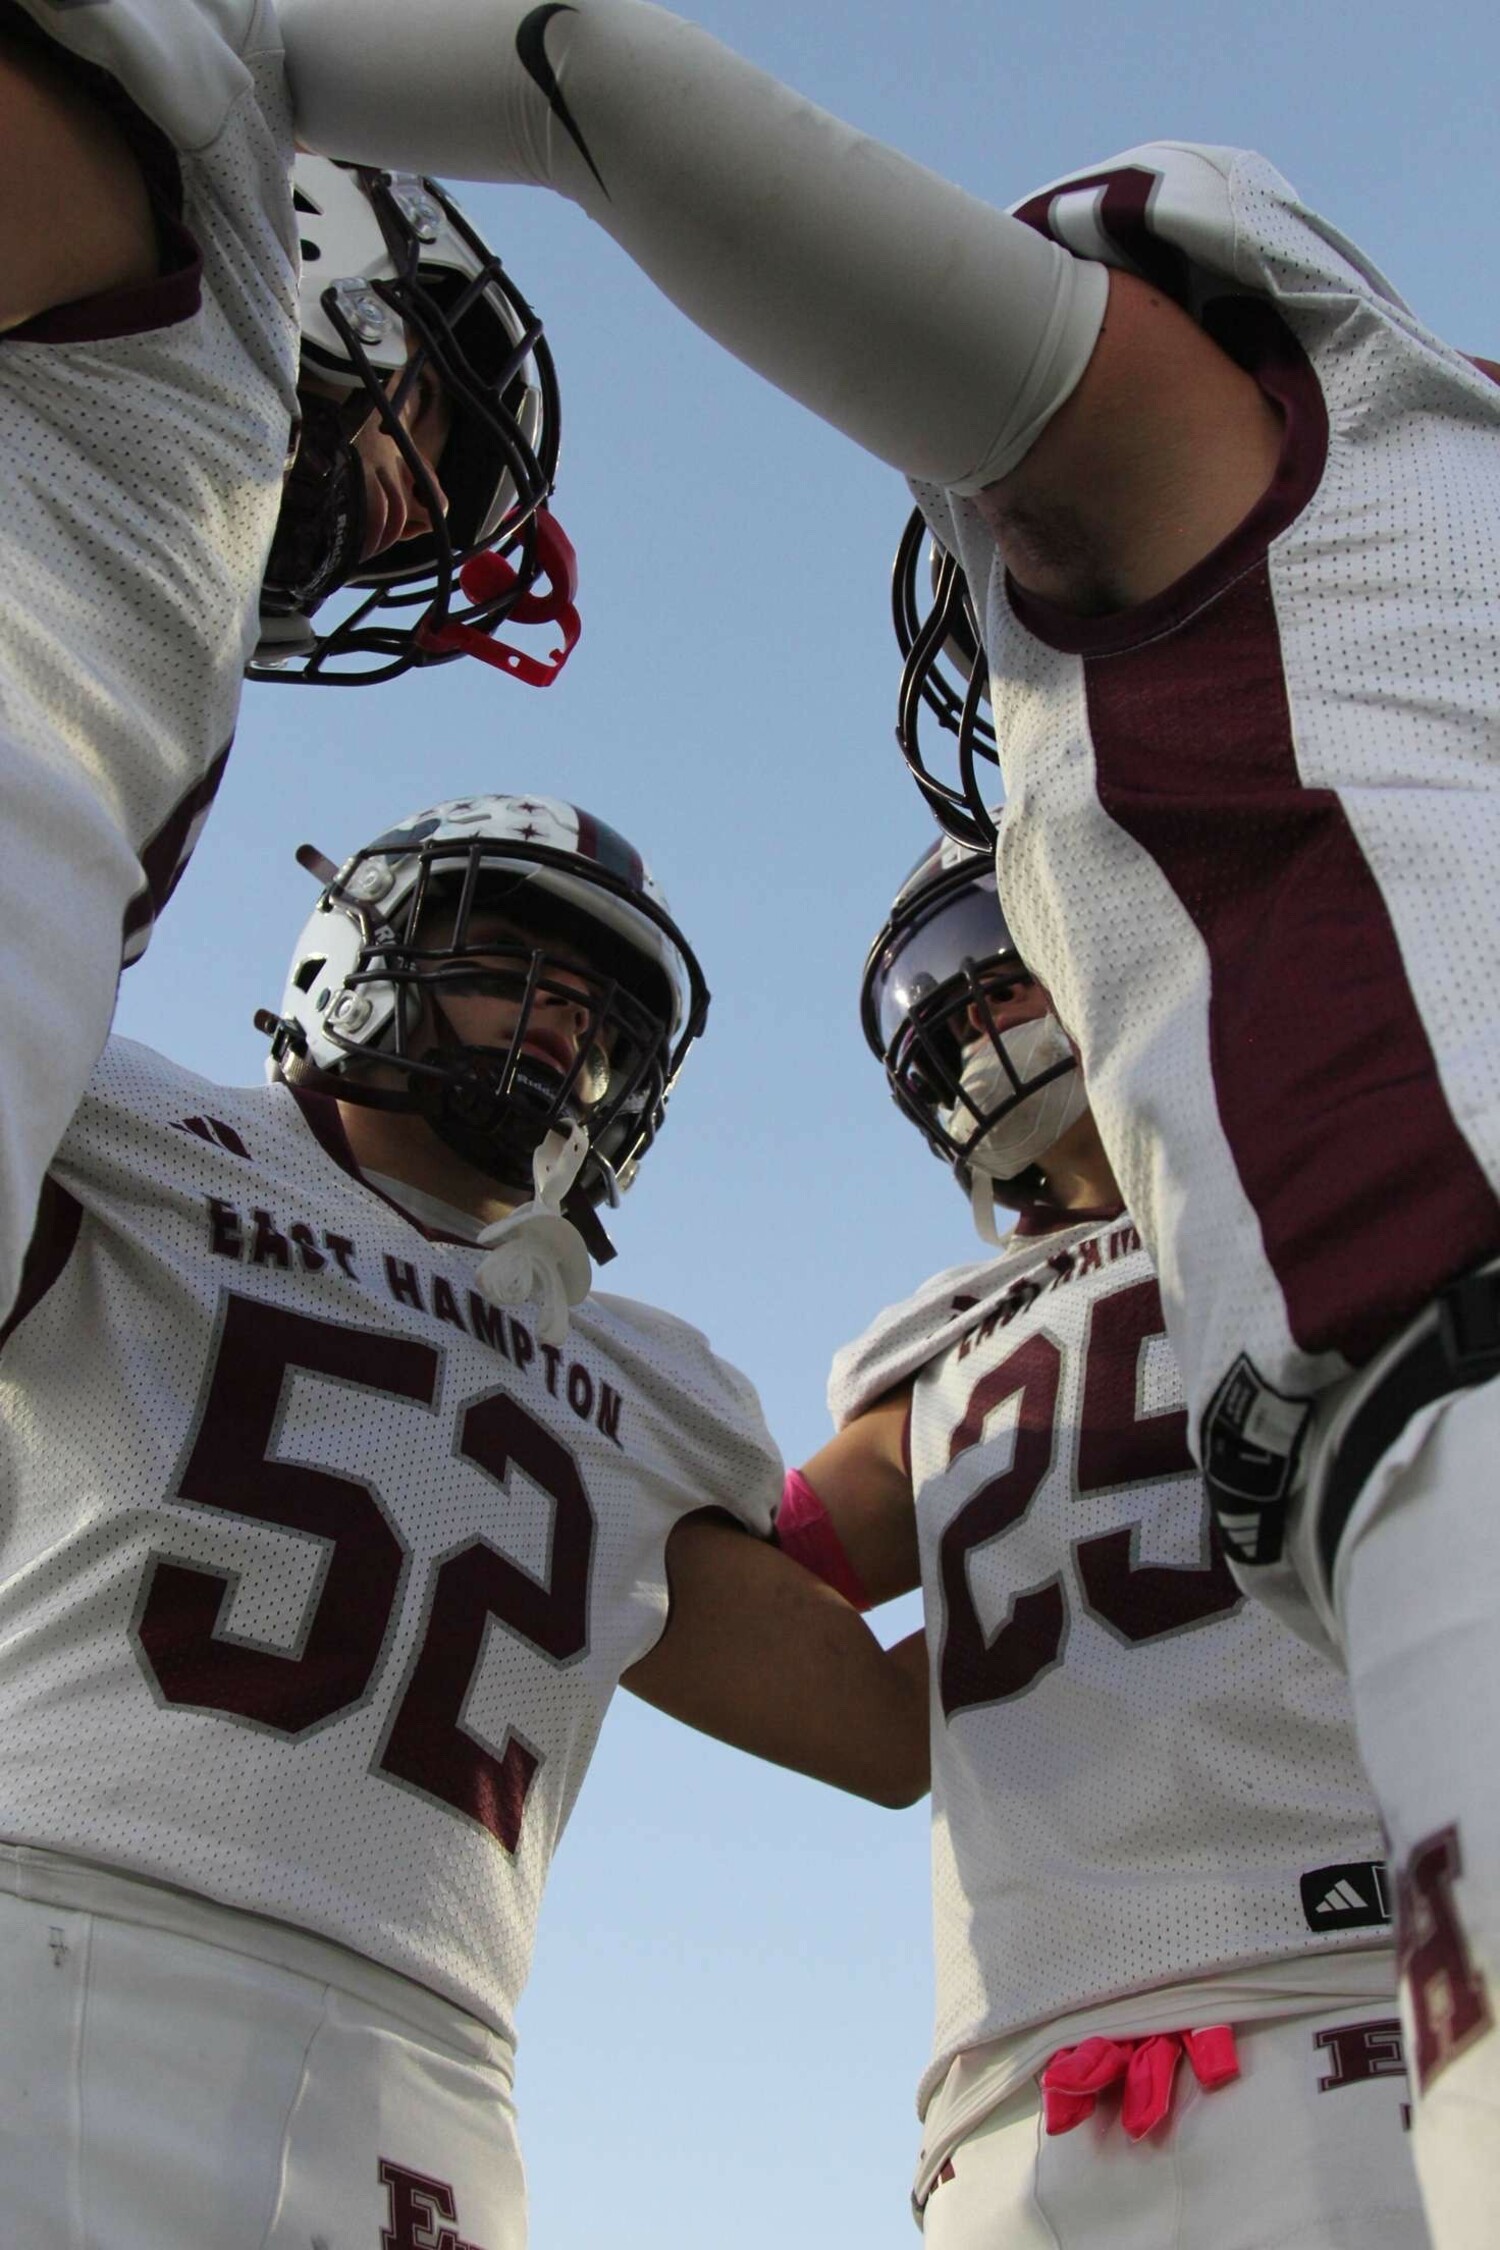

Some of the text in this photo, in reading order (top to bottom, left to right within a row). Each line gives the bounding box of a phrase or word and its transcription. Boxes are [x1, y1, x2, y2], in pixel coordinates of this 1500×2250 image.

[203, 1193, 623, 1451] EAST HAMPTON
[938, 1277, 1248, 1728] 25
[130, 1286, 598, 1866] 52
